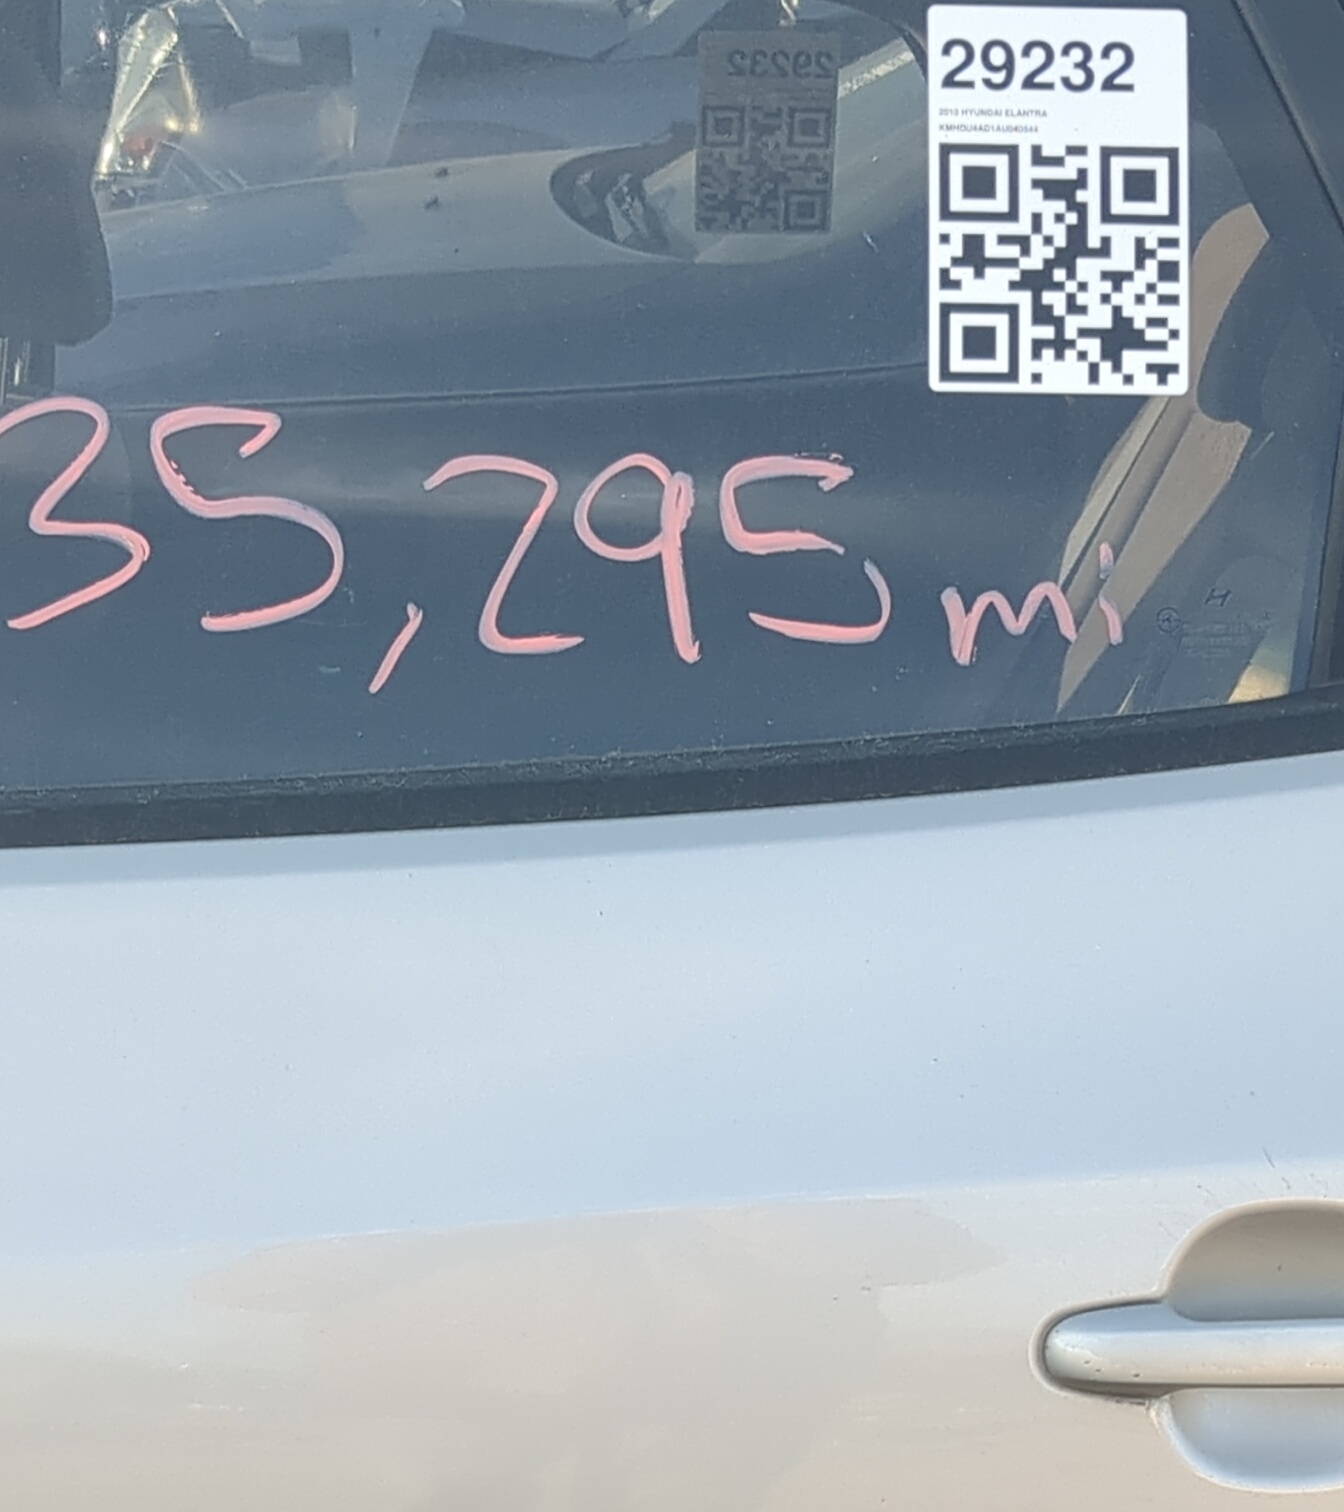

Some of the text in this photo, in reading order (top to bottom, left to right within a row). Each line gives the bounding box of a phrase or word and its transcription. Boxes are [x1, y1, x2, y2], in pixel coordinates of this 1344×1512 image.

[940, 38, 1136, 92] 29232
[939, 108, 1048, 117] 2010 HYUNDAI ELANTRA
[939, 540, 1125, 666] mi
